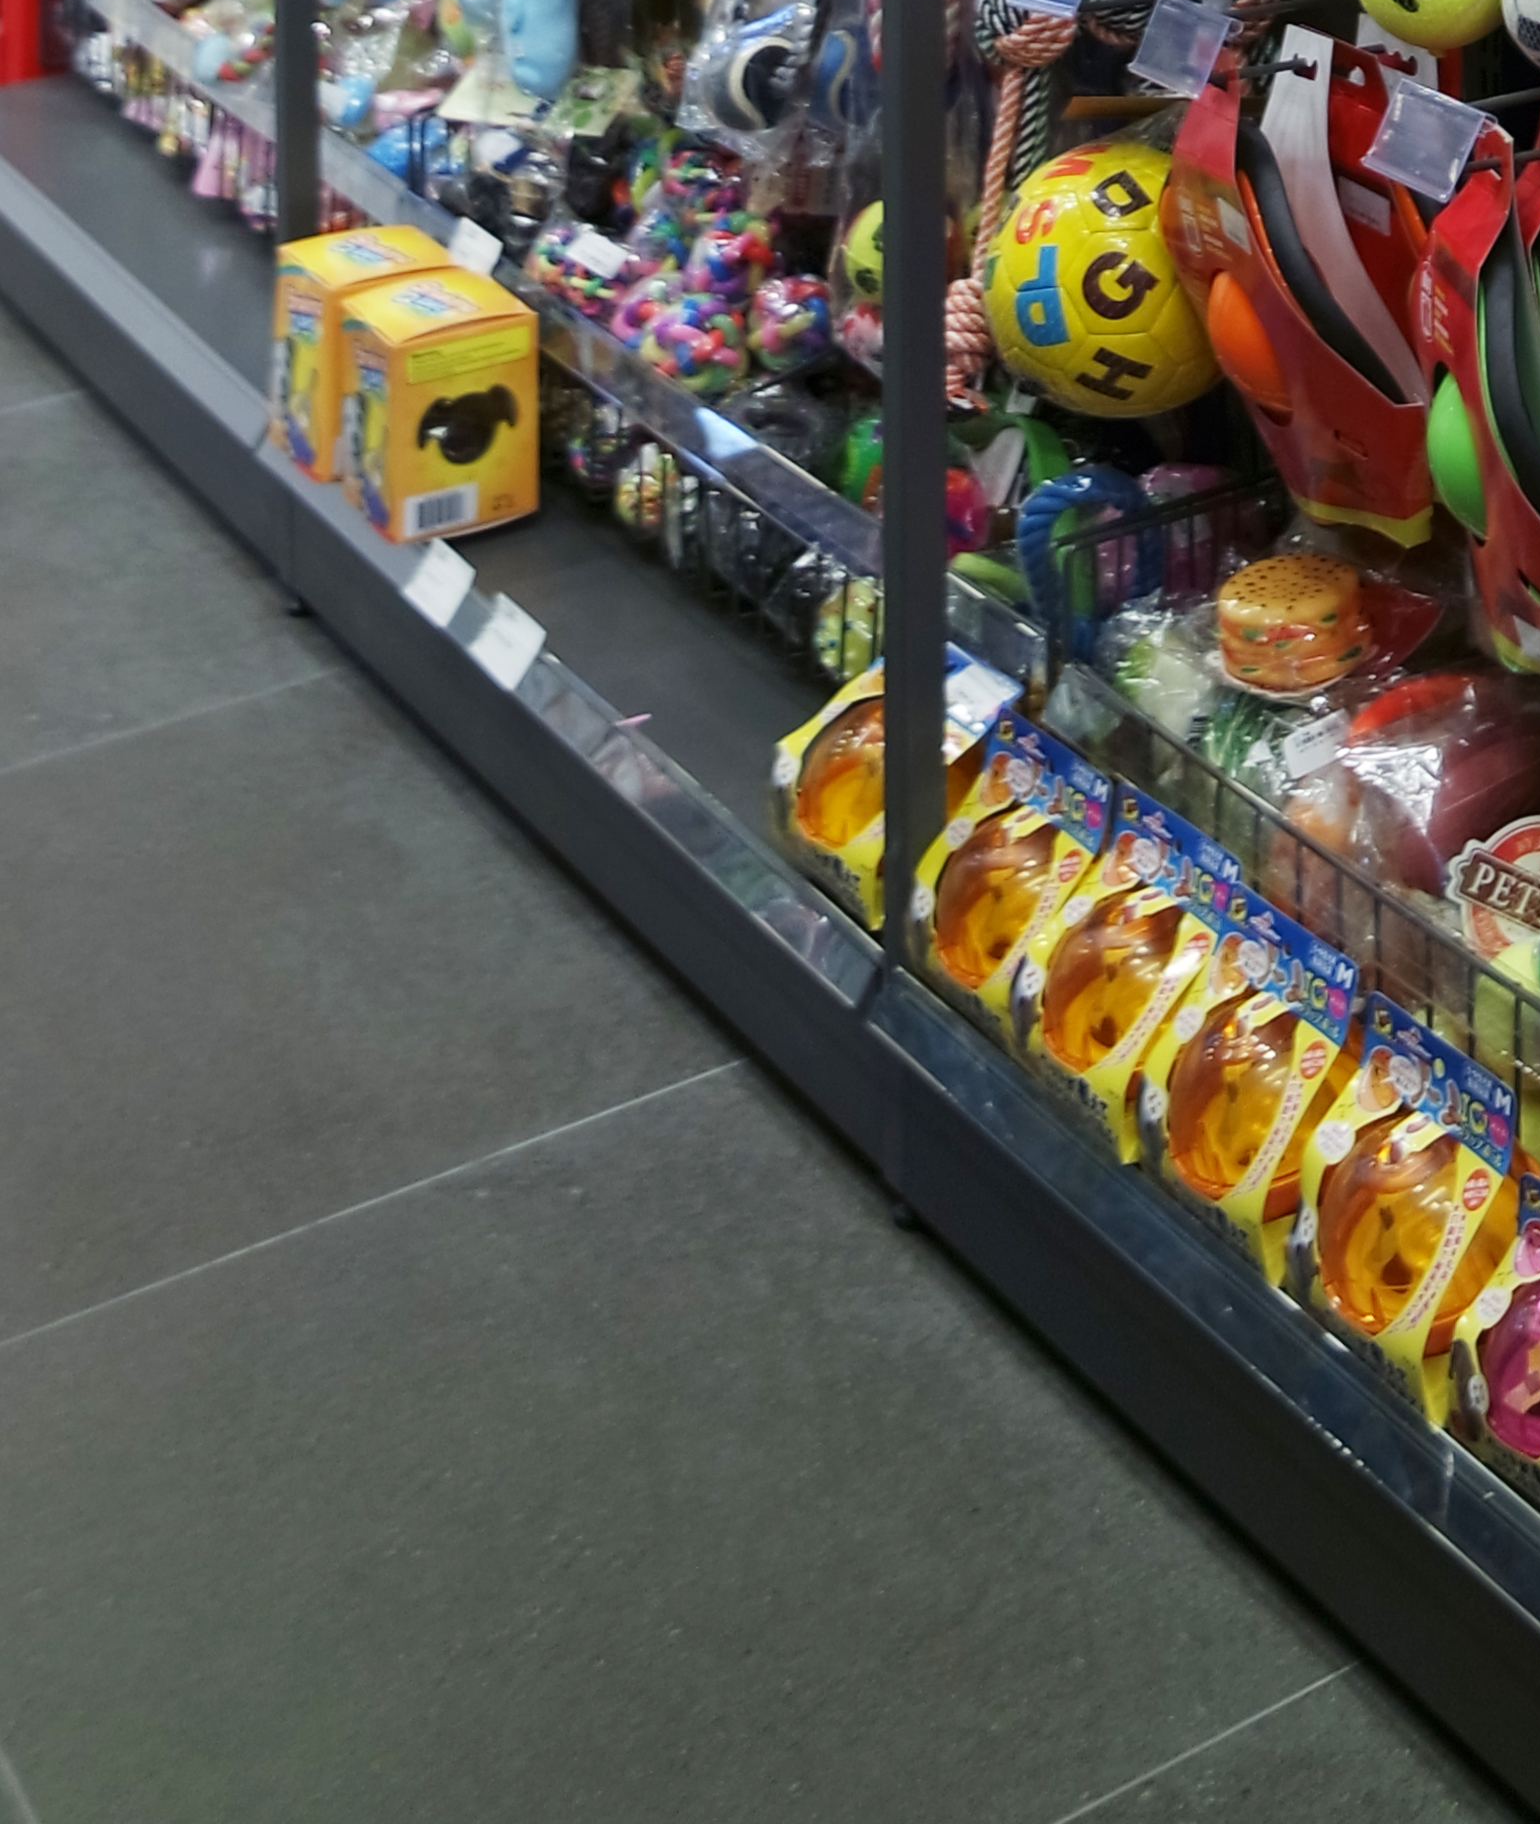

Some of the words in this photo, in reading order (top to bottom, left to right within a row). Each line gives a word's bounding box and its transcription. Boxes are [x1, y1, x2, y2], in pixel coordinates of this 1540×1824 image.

[1081, 251, 1160, 321] G
[1092, 778, 1109, 802] M
[1221, 859, 1239, 883] M
[1335, 961, 1355, 989] M
[1494, 1087, 1513, 1115] M
